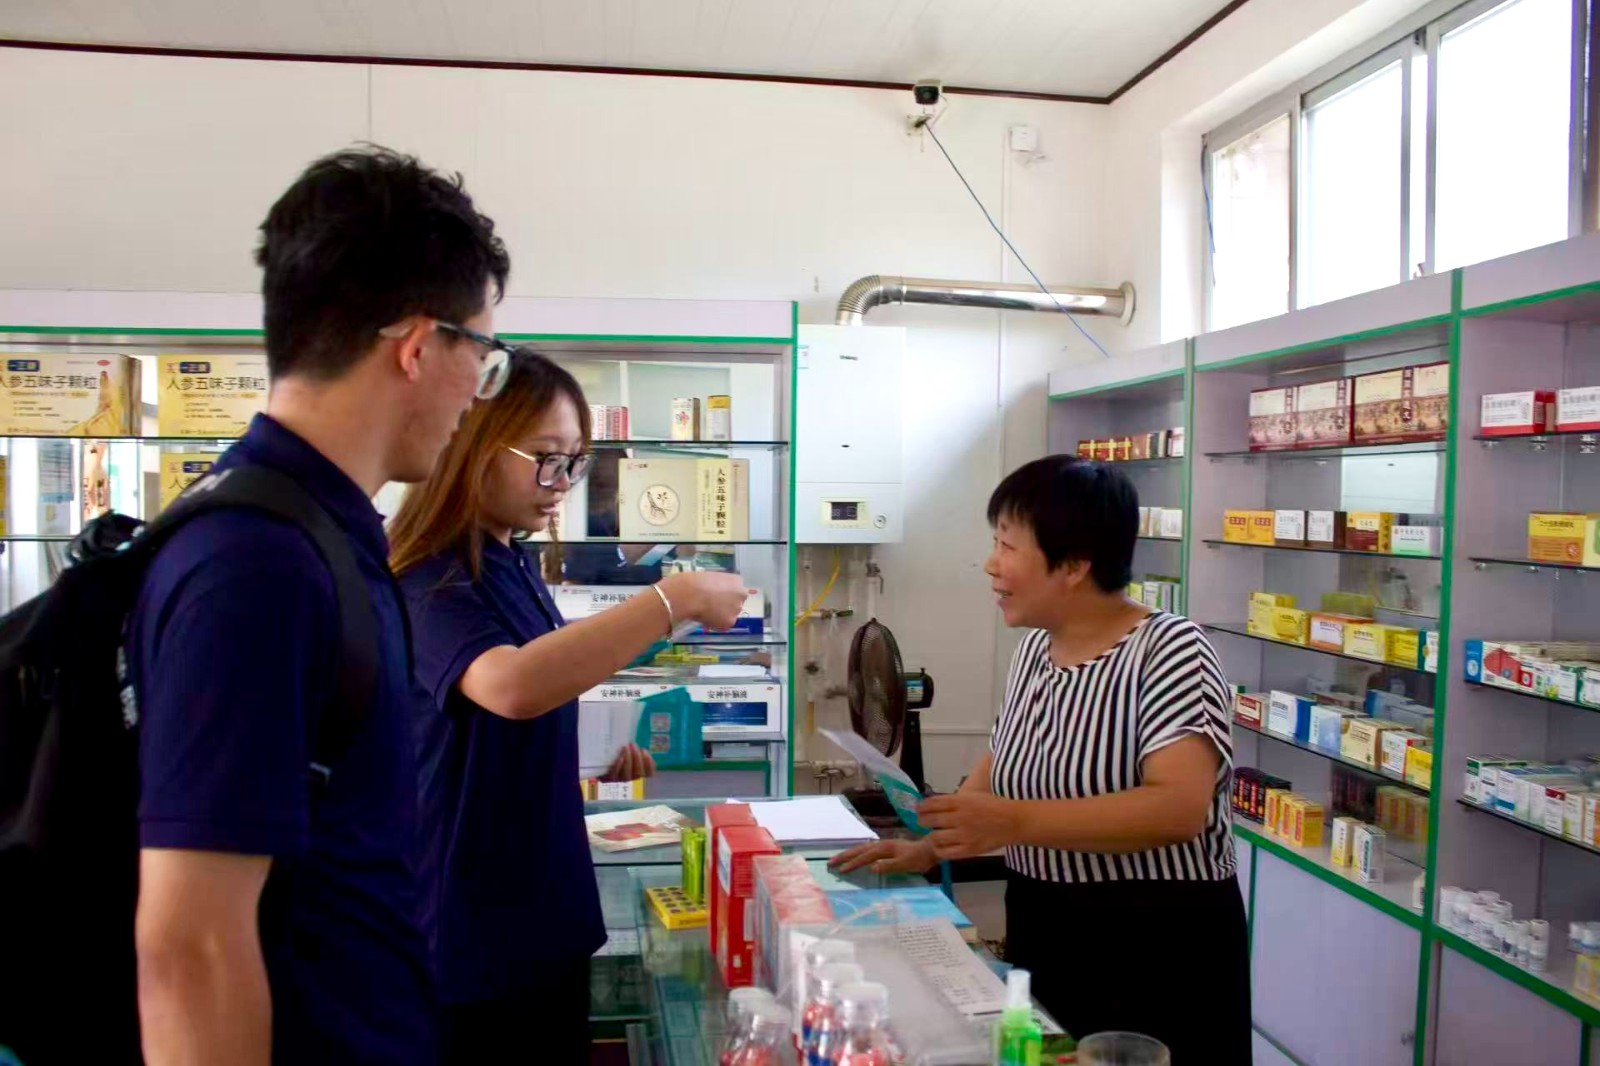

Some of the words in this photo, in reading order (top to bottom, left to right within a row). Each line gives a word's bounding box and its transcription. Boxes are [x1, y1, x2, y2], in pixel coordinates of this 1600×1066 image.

[166, 376, 266, 390] 人参五味子颗粒
